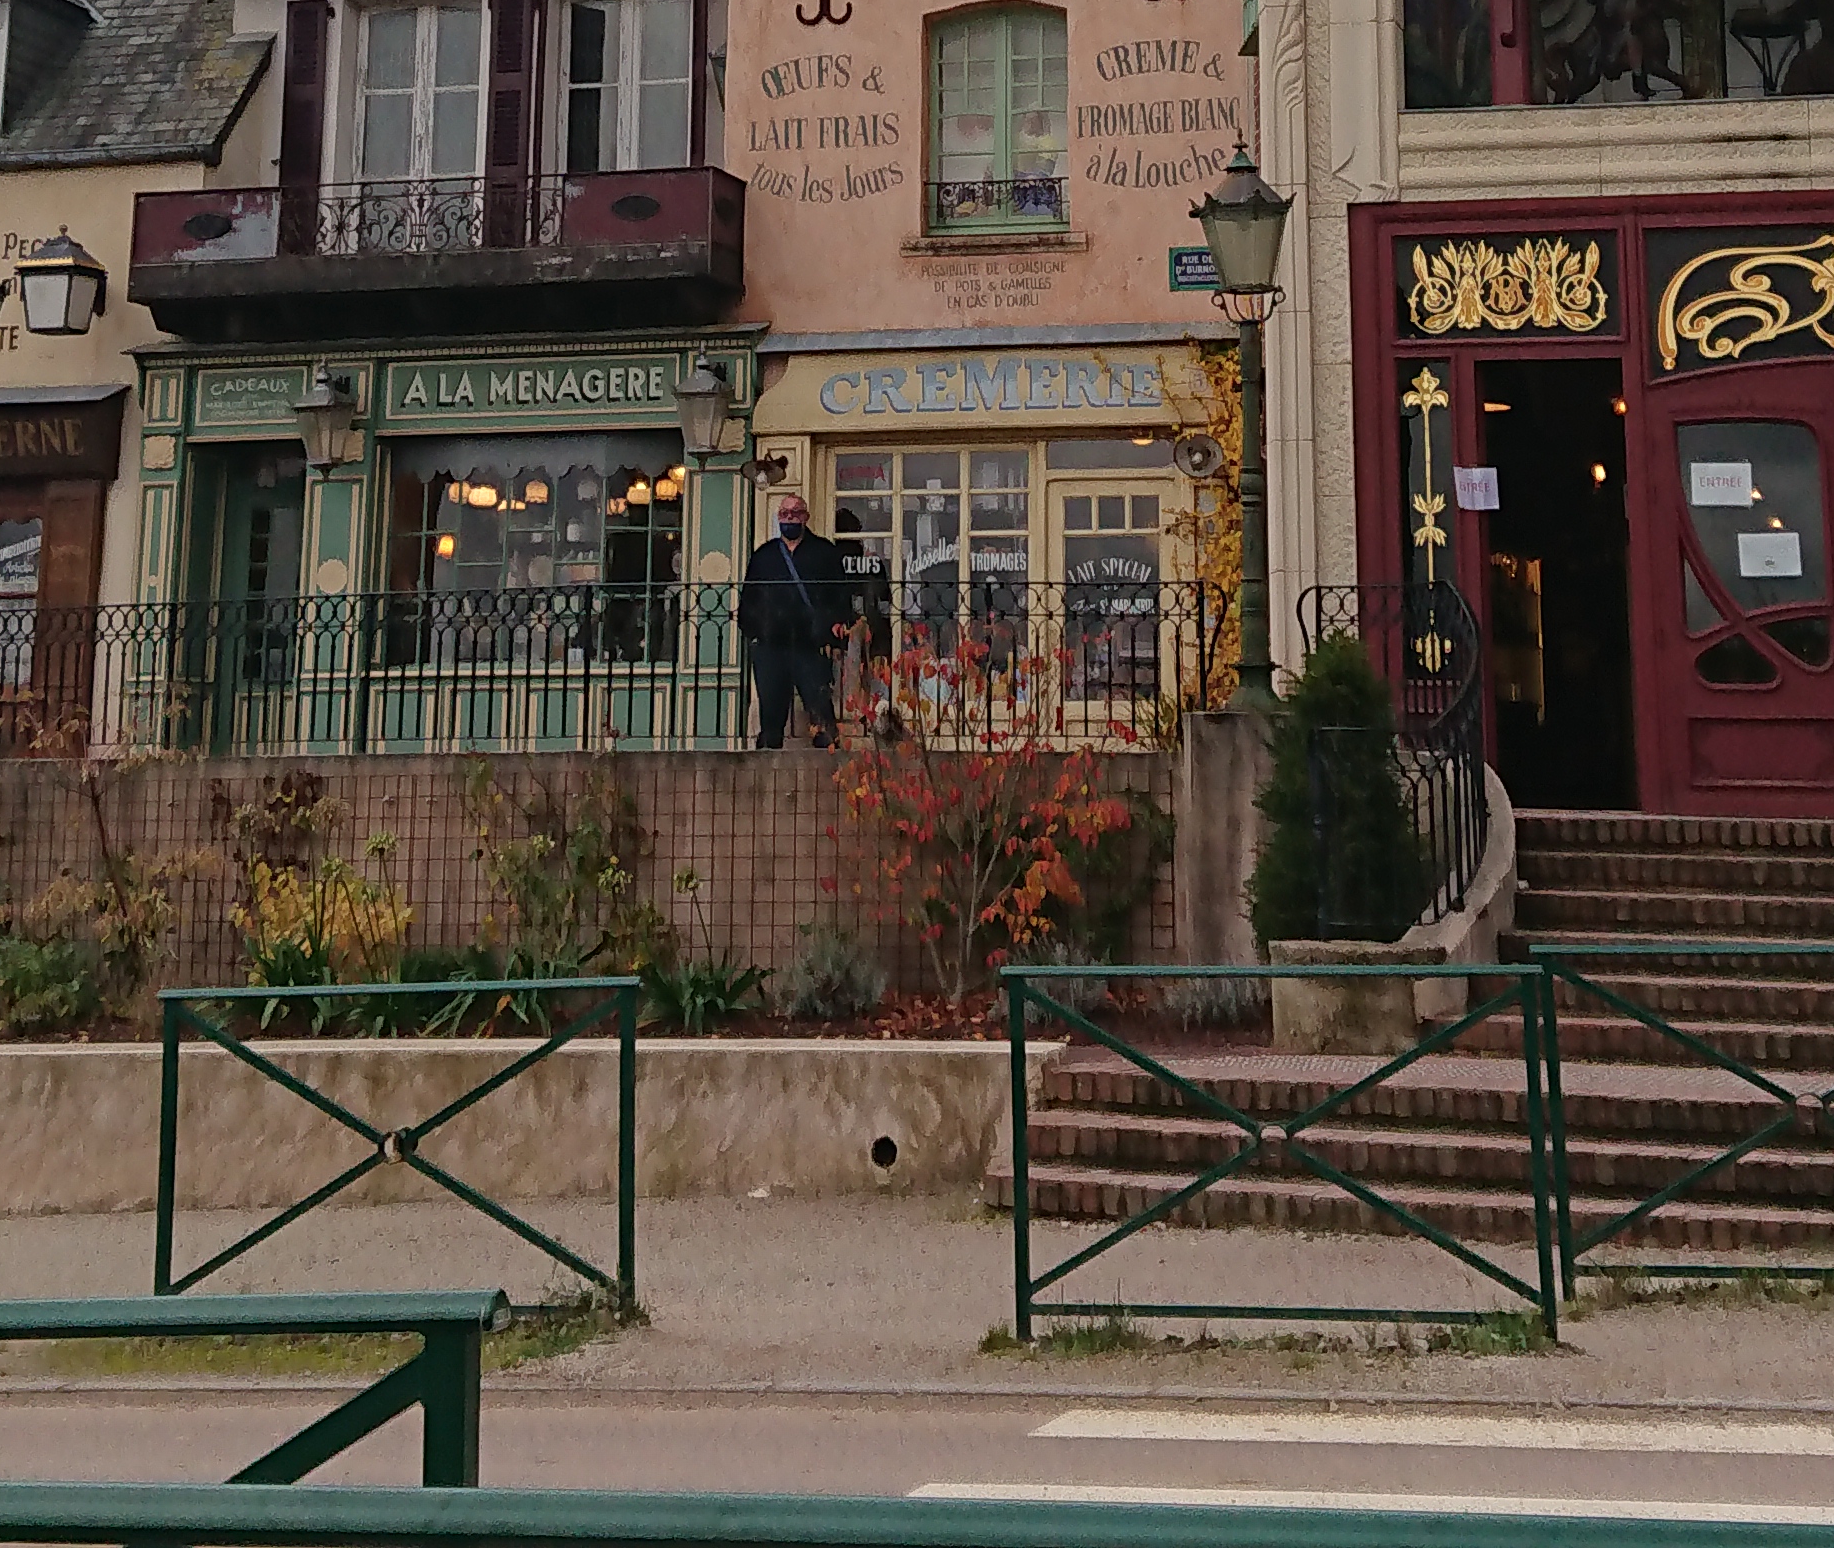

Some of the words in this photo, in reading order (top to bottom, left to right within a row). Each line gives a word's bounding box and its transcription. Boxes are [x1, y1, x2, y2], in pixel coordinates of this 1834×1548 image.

[761, 54, 853, 100] ŒUFS
[861, 65, 886, 95] &
[1096, 39, 1201, 83] CREME
[1202, 52, 1225, 82] &
[747, 117, 809, 153] LAIT
[817, 112, 900, 149] FRAIS
[1076, 100, 1175, 139] FROMAGE
[1179, 97, 1240, 133] BLANC
[749, 161, 797, 199] tous
[799, 164, 834, 204] les
[1103, 146, 1128, 188] la
[955, 279, 982, 292] POTS
[985, 262, 1000, 275] DE
[1008, 260, 1067, 275] CONSIGNE
[1186, 265, 1216, 274] BURNO
[947, 295, 962, 309] EN
[966, 294, 988, 309] CAS
[210, 377, 290, 396] CADEAUX
[401, 369, 429, 407] A
[437, 369, 475, 407] LA
[487, 366, 665, 406] MENAGERE
[819, 356, 1163, 415] CREMERIE
[970, 551, 1027, 572] FROMAGES
